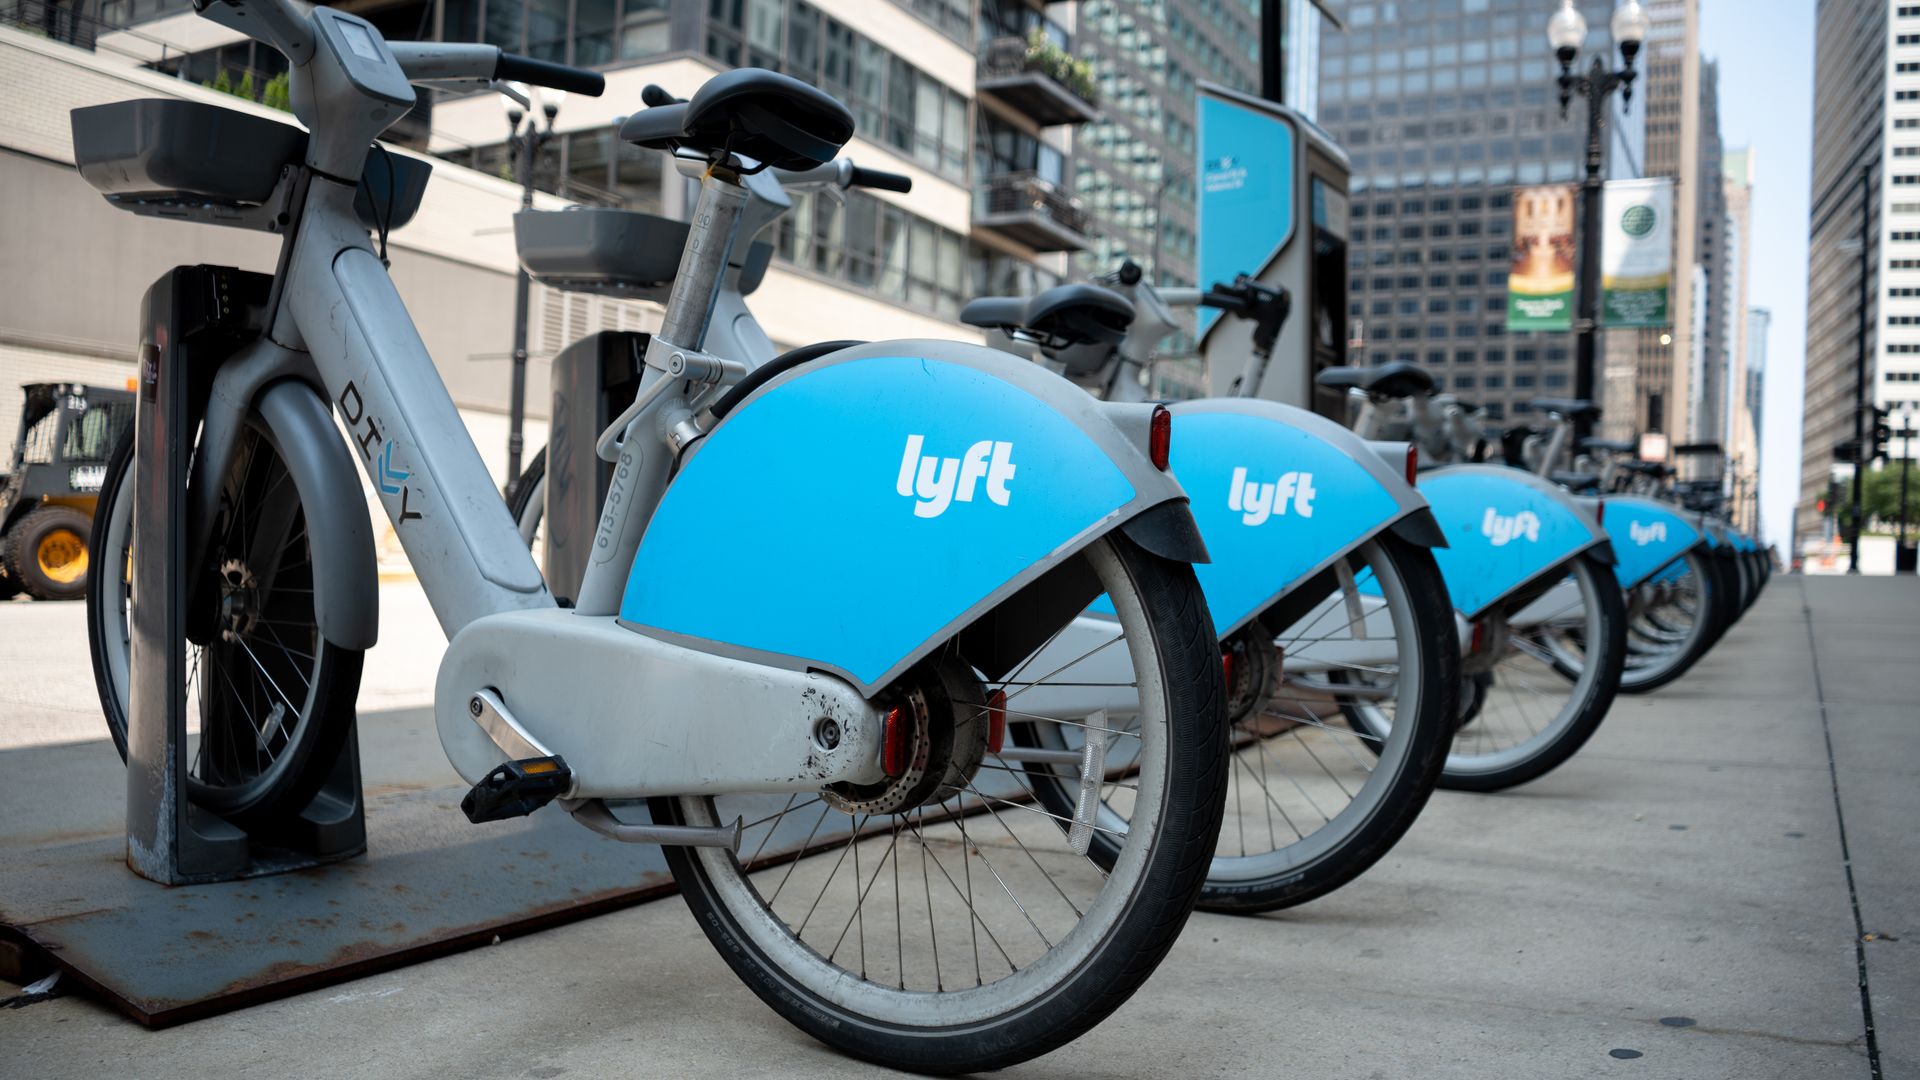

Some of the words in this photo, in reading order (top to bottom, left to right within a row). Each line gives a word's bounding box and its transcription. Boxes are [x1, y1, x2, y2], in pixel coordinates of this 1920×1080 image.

[596, 451, 633, 550] 613-5768
[896, 433, 1017, 519] lyft
[1228, 466, 1317, 527] lyft
[1482, 508, 1541, 546] lyft
[1629, 519, 1667, 546] lyft
